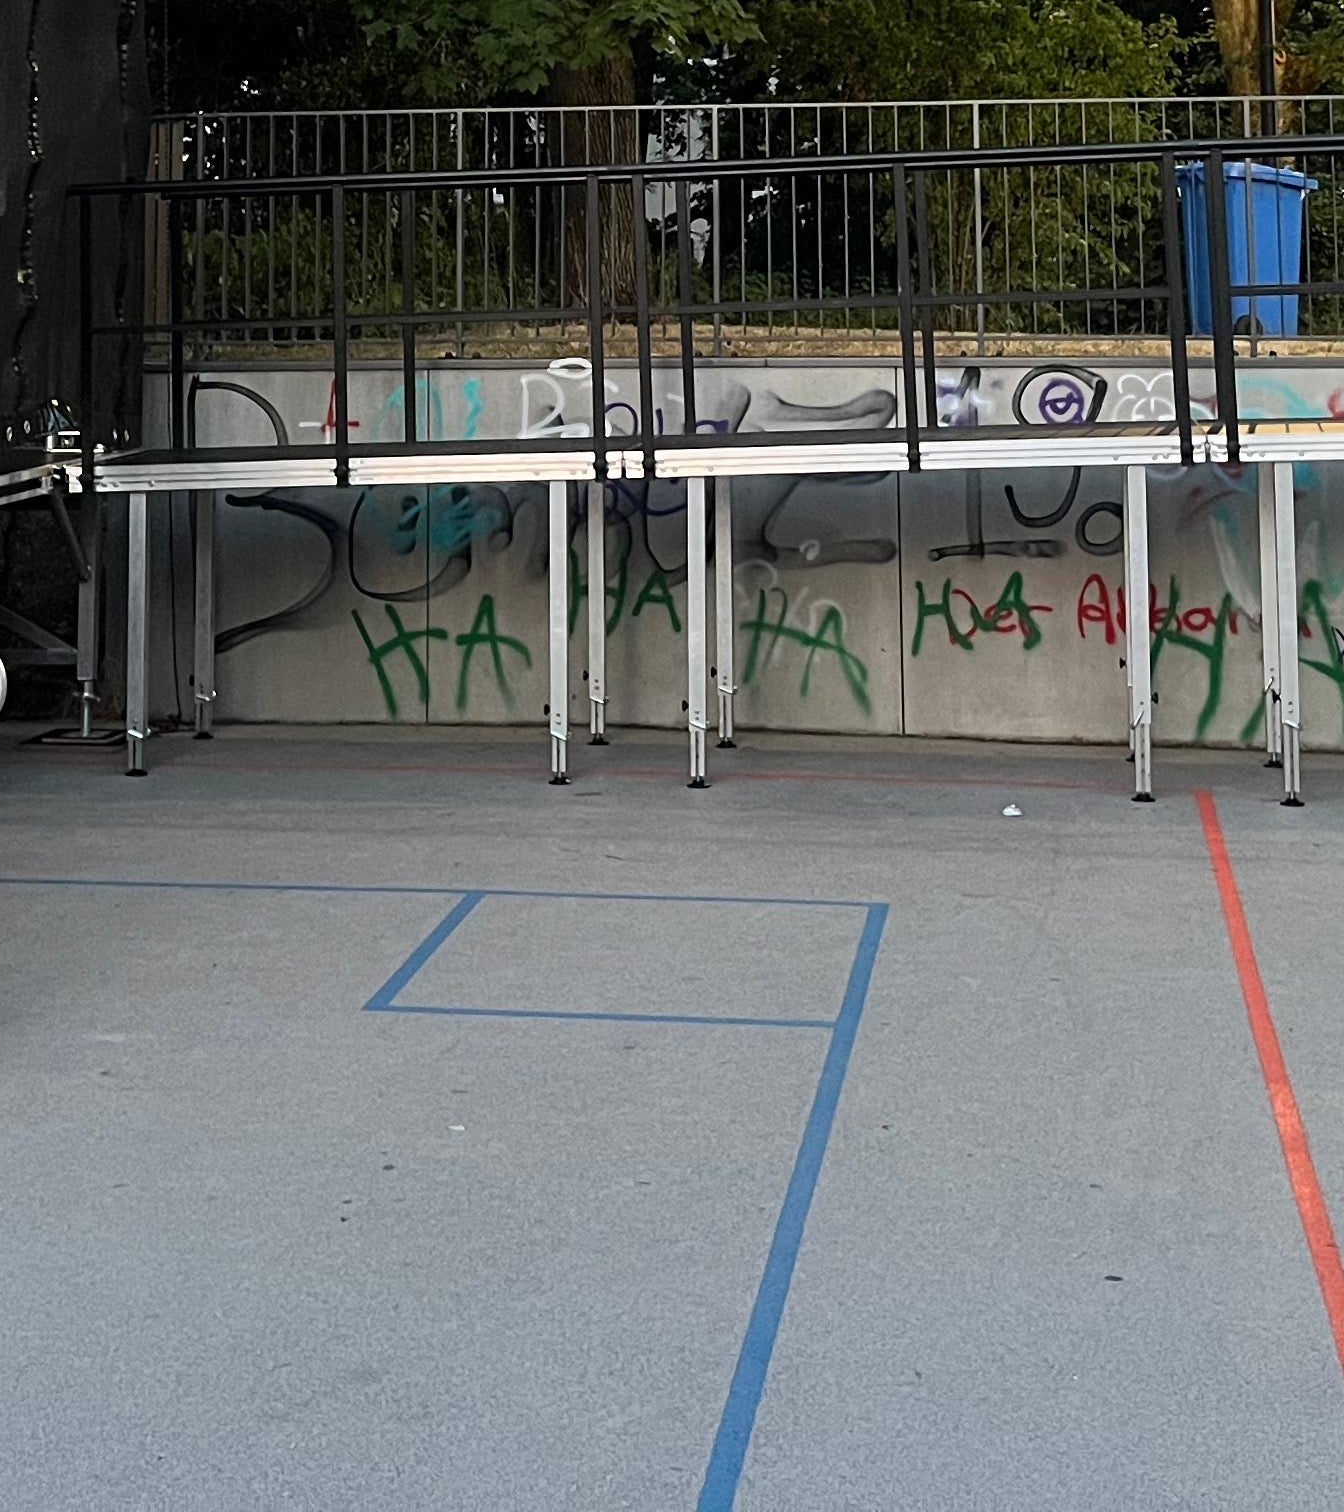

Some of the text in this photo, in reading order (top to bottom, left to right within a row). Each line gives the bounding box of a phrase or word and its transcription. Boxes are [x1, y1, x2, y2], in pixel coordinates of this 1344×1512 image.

[568, 543, 683, 636] HA
[910, 571, 1043, 657] HA
[351, 594, 534, 718] HA
[741, 588, 871, 716] HA
